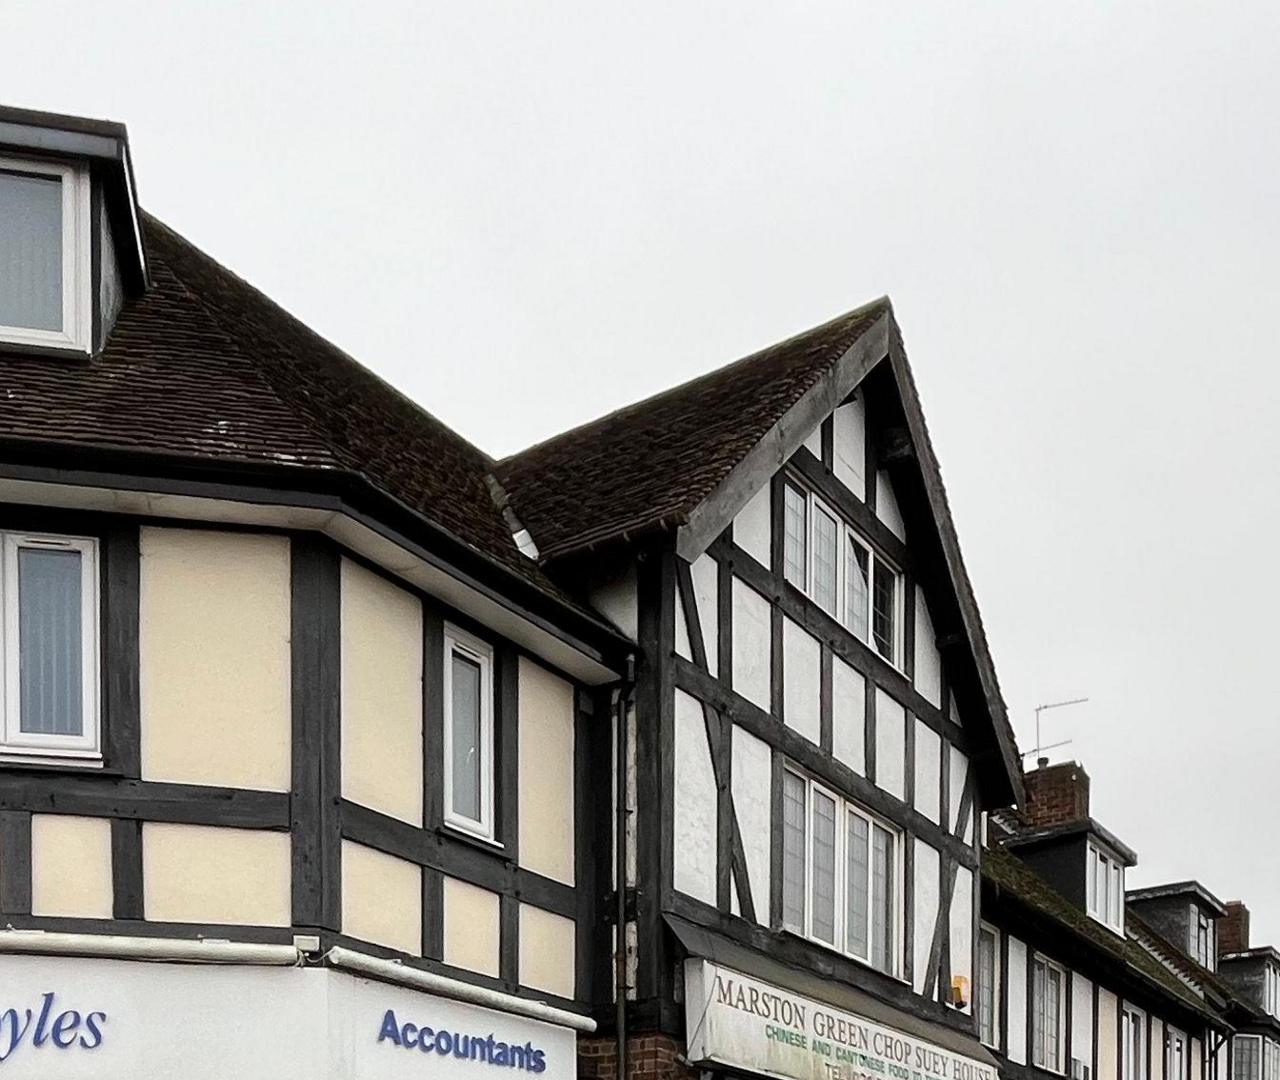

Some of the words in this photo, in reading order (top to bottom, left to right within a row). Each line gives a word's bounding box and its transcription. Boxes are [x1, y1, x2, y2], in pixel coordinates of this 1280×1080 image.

[377, 1009, 546, 1073] Accountants
[716, 976, 805, 1031] MARSTON
[813, 1011, 869, 1052] GREEN
[873, 1032, 911, 1063] CHOP
[916, 1046, 949, 1077] SUEY
[765, 1025, 808, 1050] CHINESE
[812, 1041, 831, 1058] AND
[836, 1048, 885, 1074] CANTONESE
[889, 1064, 909, 1080] FOOD
